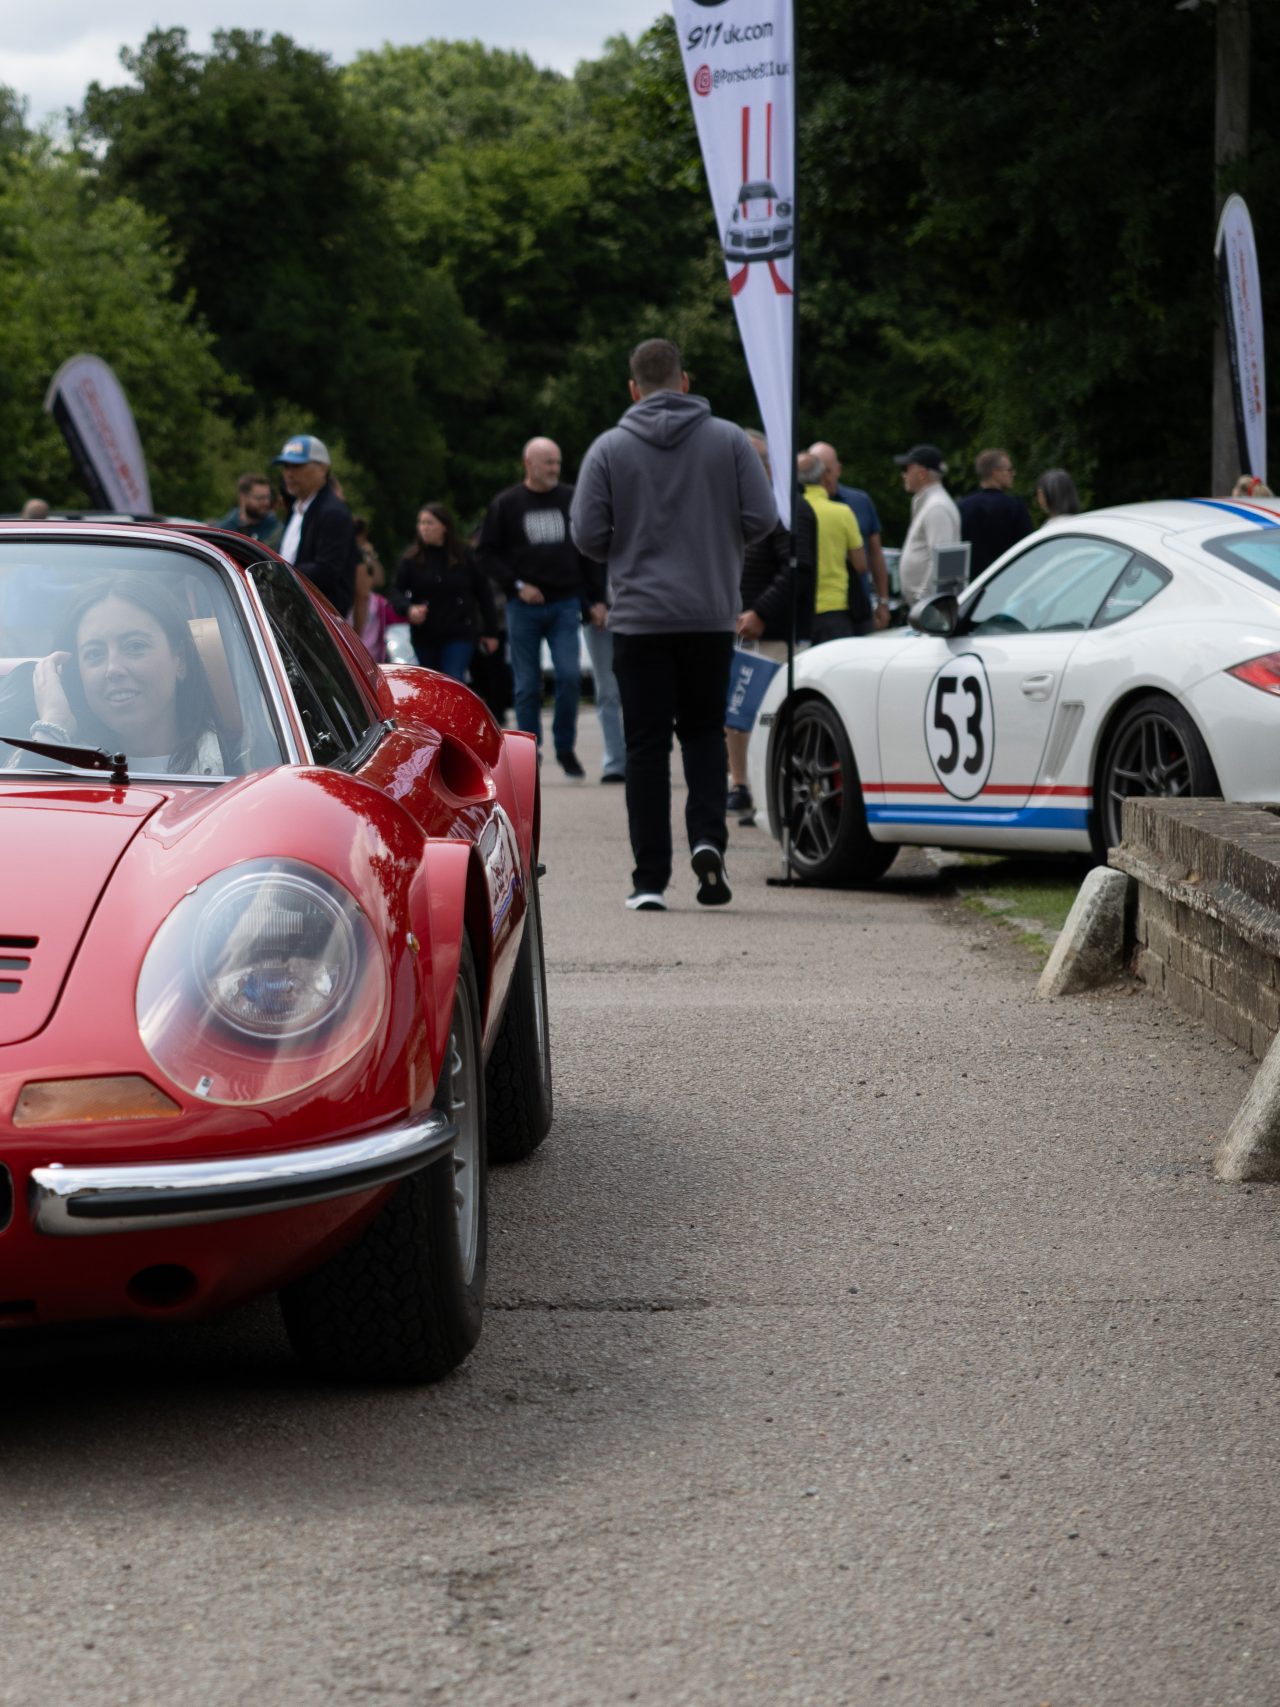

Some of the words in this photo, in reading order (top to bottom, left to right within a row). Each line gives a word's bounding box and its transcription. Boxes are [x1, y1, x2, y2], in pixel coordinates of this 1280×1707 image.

[686, 22, 773, 51] 911uk.com
[728, 664, 754, 716] MEYLE
[934, 675, 985, 776] 53
